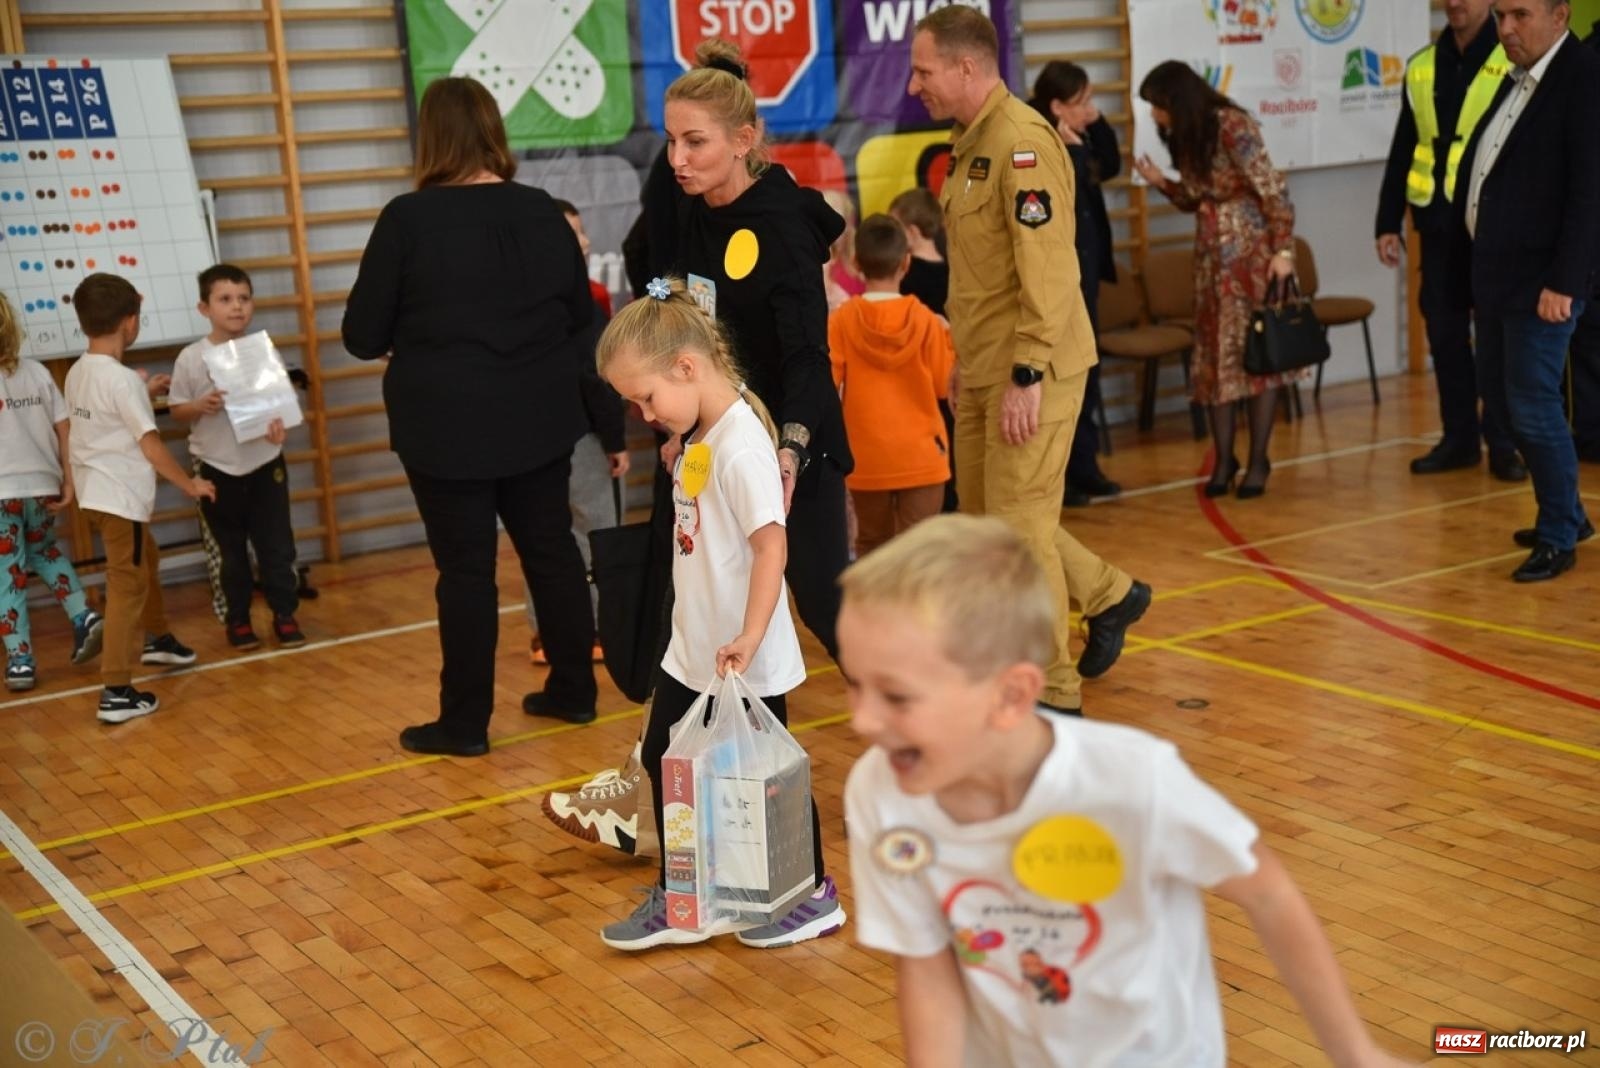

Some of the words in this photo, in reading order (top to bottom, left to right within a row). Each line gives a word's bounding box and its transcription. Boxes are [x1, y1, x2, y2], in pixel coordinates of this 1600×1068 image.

[700, 0, 796, 36] STOP
[12, 76, 34, 103] 12
[47, 77, 69, 104] 14
[79, 77, 101, 106] 26
[20, 110, 39, 127] P
[54, 110, 74, 128] P
[88, 113, 108, 130] P
